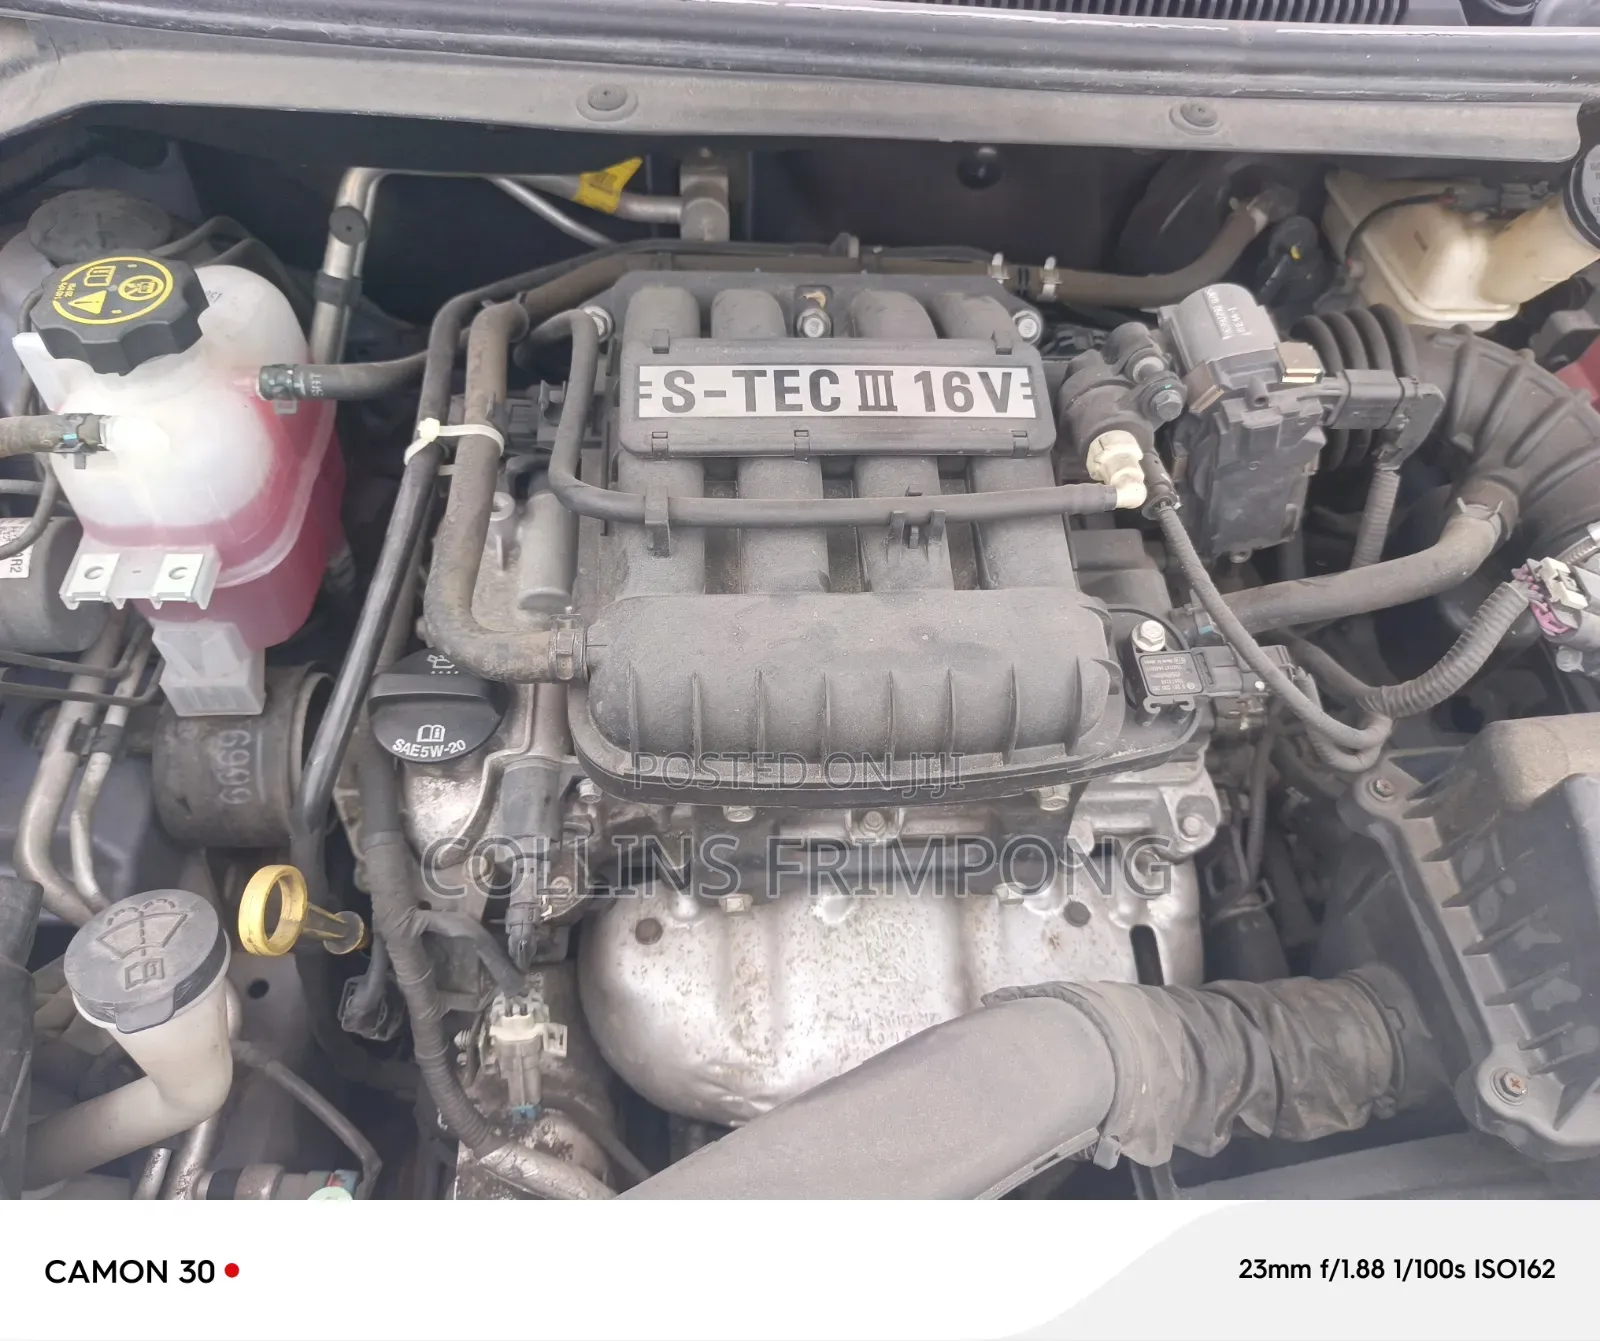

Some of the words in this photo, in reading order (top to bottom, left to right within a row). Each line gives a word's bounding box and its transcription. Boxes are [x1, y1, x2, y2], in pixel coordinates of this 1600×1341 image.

[661, 369, 841, 414] S-TEC
[854, 369, 898, 413] III
[913, 370, 1012, 414] 16V
